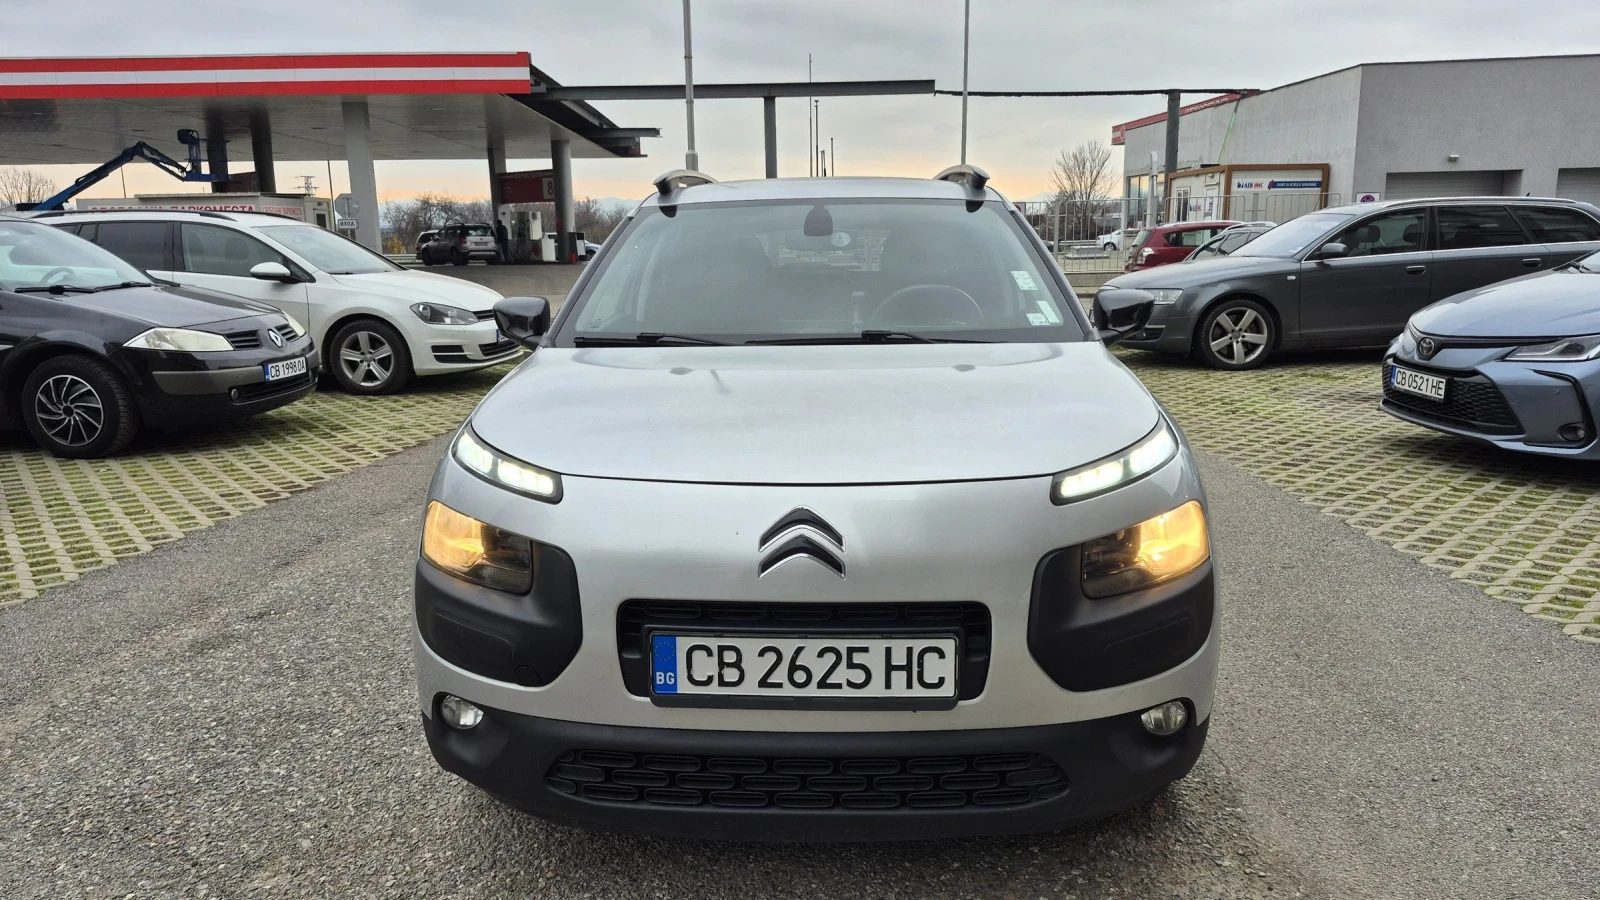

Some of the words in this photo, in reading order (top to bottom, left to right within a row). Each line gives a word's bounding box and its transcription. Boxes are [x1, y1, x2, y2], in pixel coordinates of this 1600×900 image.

[547, 181, 553, 195] 8
[270, 365, 280, 378] CB
[282, 361, 297, 375] 1998
[1396, 370, 1407, 386] CB
[1408, 373, 1429, 393] 0521
[1430, 379, 1444, 397] HE
[685, 643, 745, 687] CB
[757, 645, 873, 690] 2625
[884, 645, 946, 690] HC
[656, 672, 675, 685] BG
